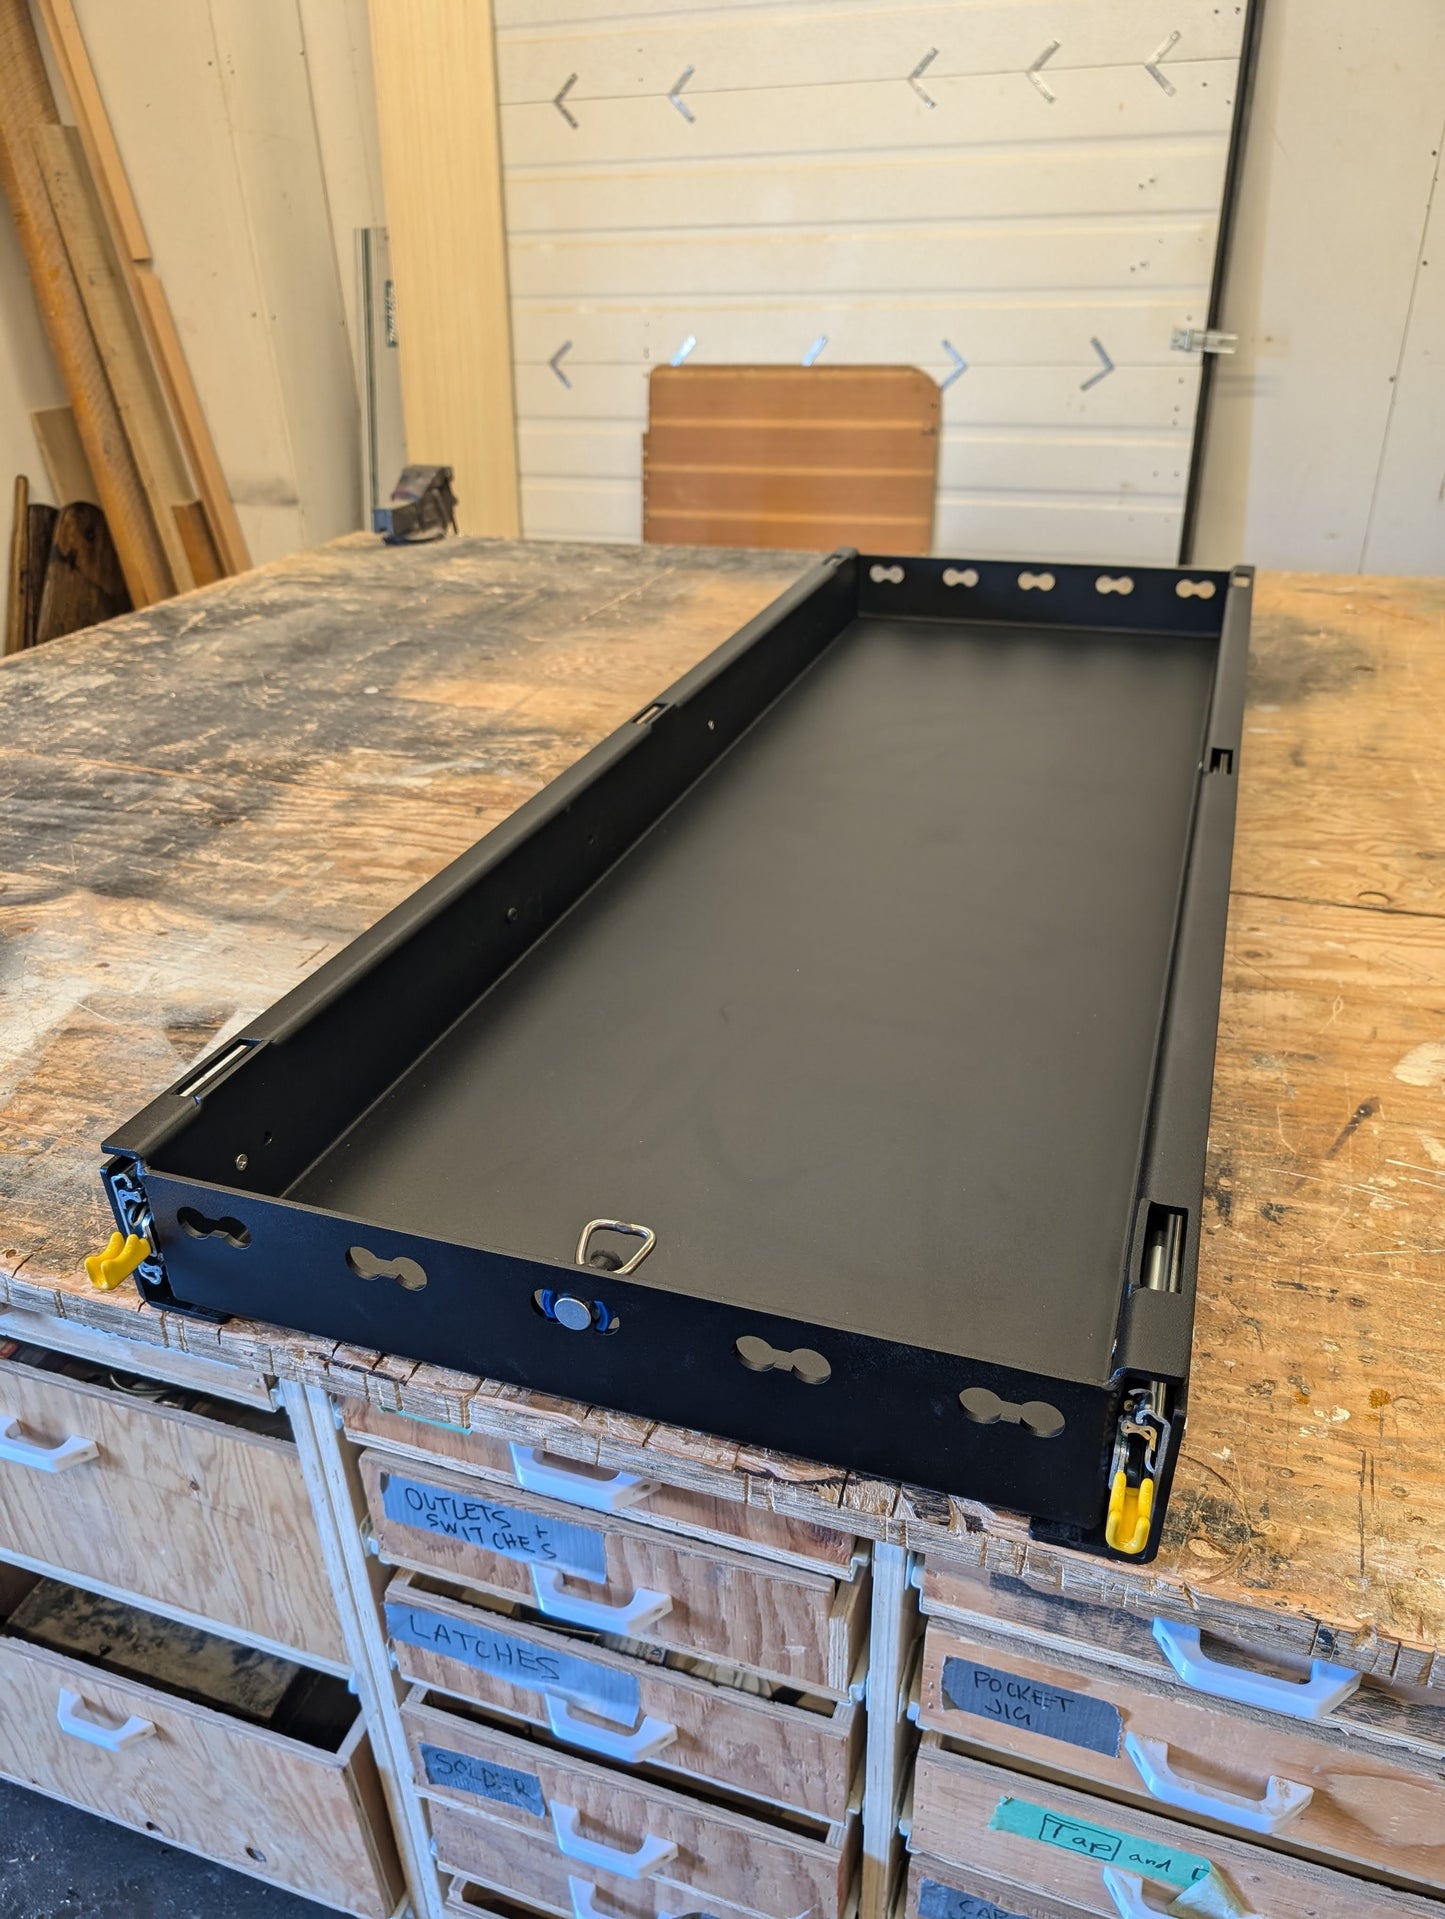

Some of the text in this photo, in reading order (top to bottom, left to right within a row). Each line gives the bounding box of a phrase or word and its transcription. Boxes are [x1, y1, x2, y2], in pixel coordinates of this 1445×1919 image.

[404, 1487, 512, 1530] OUTLETS
[425, 1513, 558, 1560] SWITCHES
[409, 1614, 560, 1681] LATCHES
[973, 1670, 1076, 1713] POCKET
[983, 1699, 1031, 1726] JIG
[1045, 1817, 1113, 1854] Tap
[1128, 1852, 1173, 1873] and
